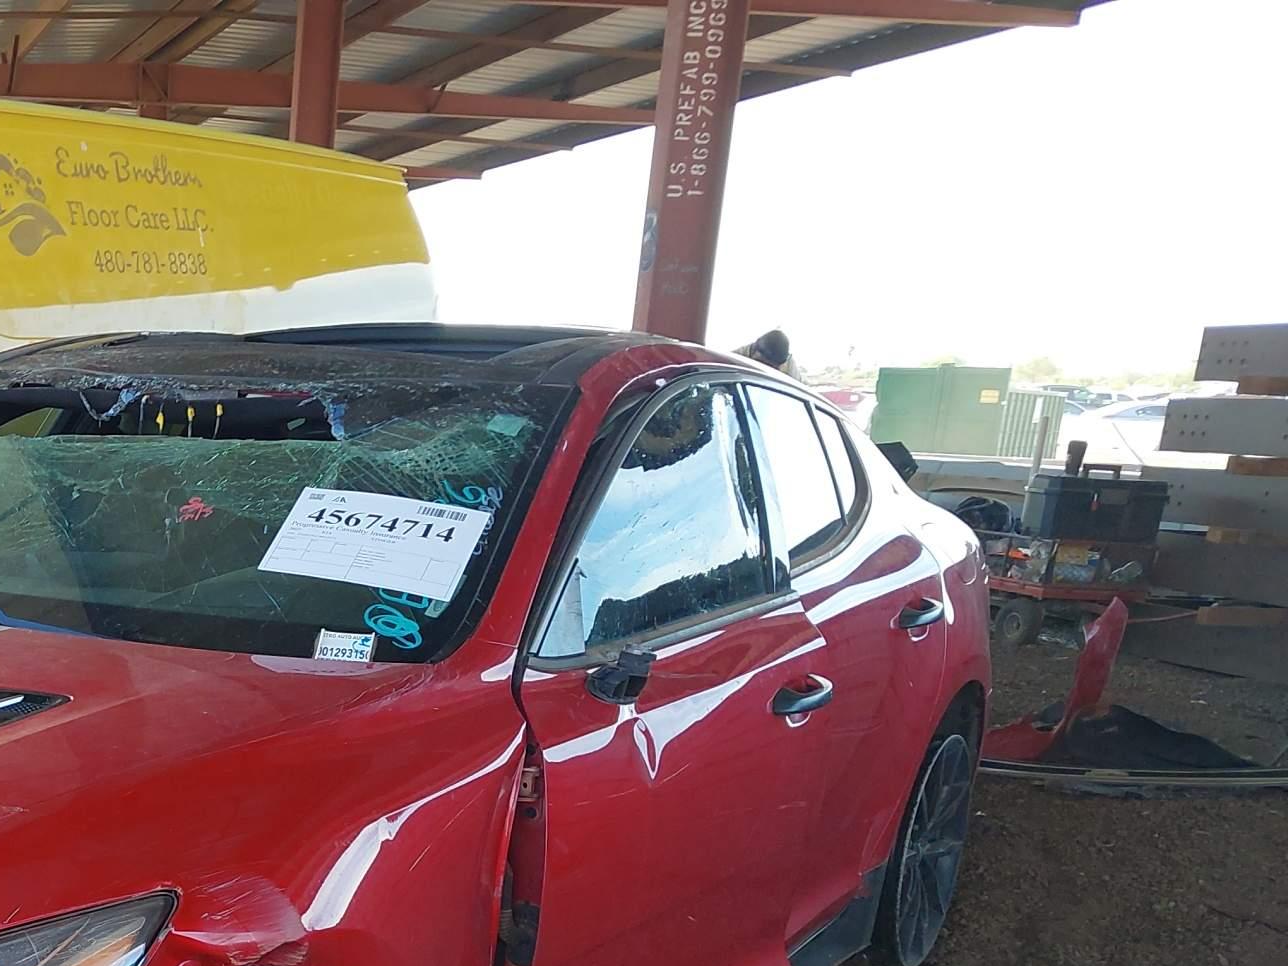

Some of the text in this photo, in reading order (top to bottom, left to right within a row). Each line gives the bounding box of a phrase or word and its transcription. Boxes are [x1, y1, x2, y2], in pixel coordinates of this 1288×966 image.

[673, 51, 700, 141] PREFAB
[55, 147, 109, 180] Euro
[65, 200, 120, 228] Floor
[124, 204, 170, 231] Care
[94, 249, 208, 276] 480-781-8838
[306, 507, 456, 543] 45674714
